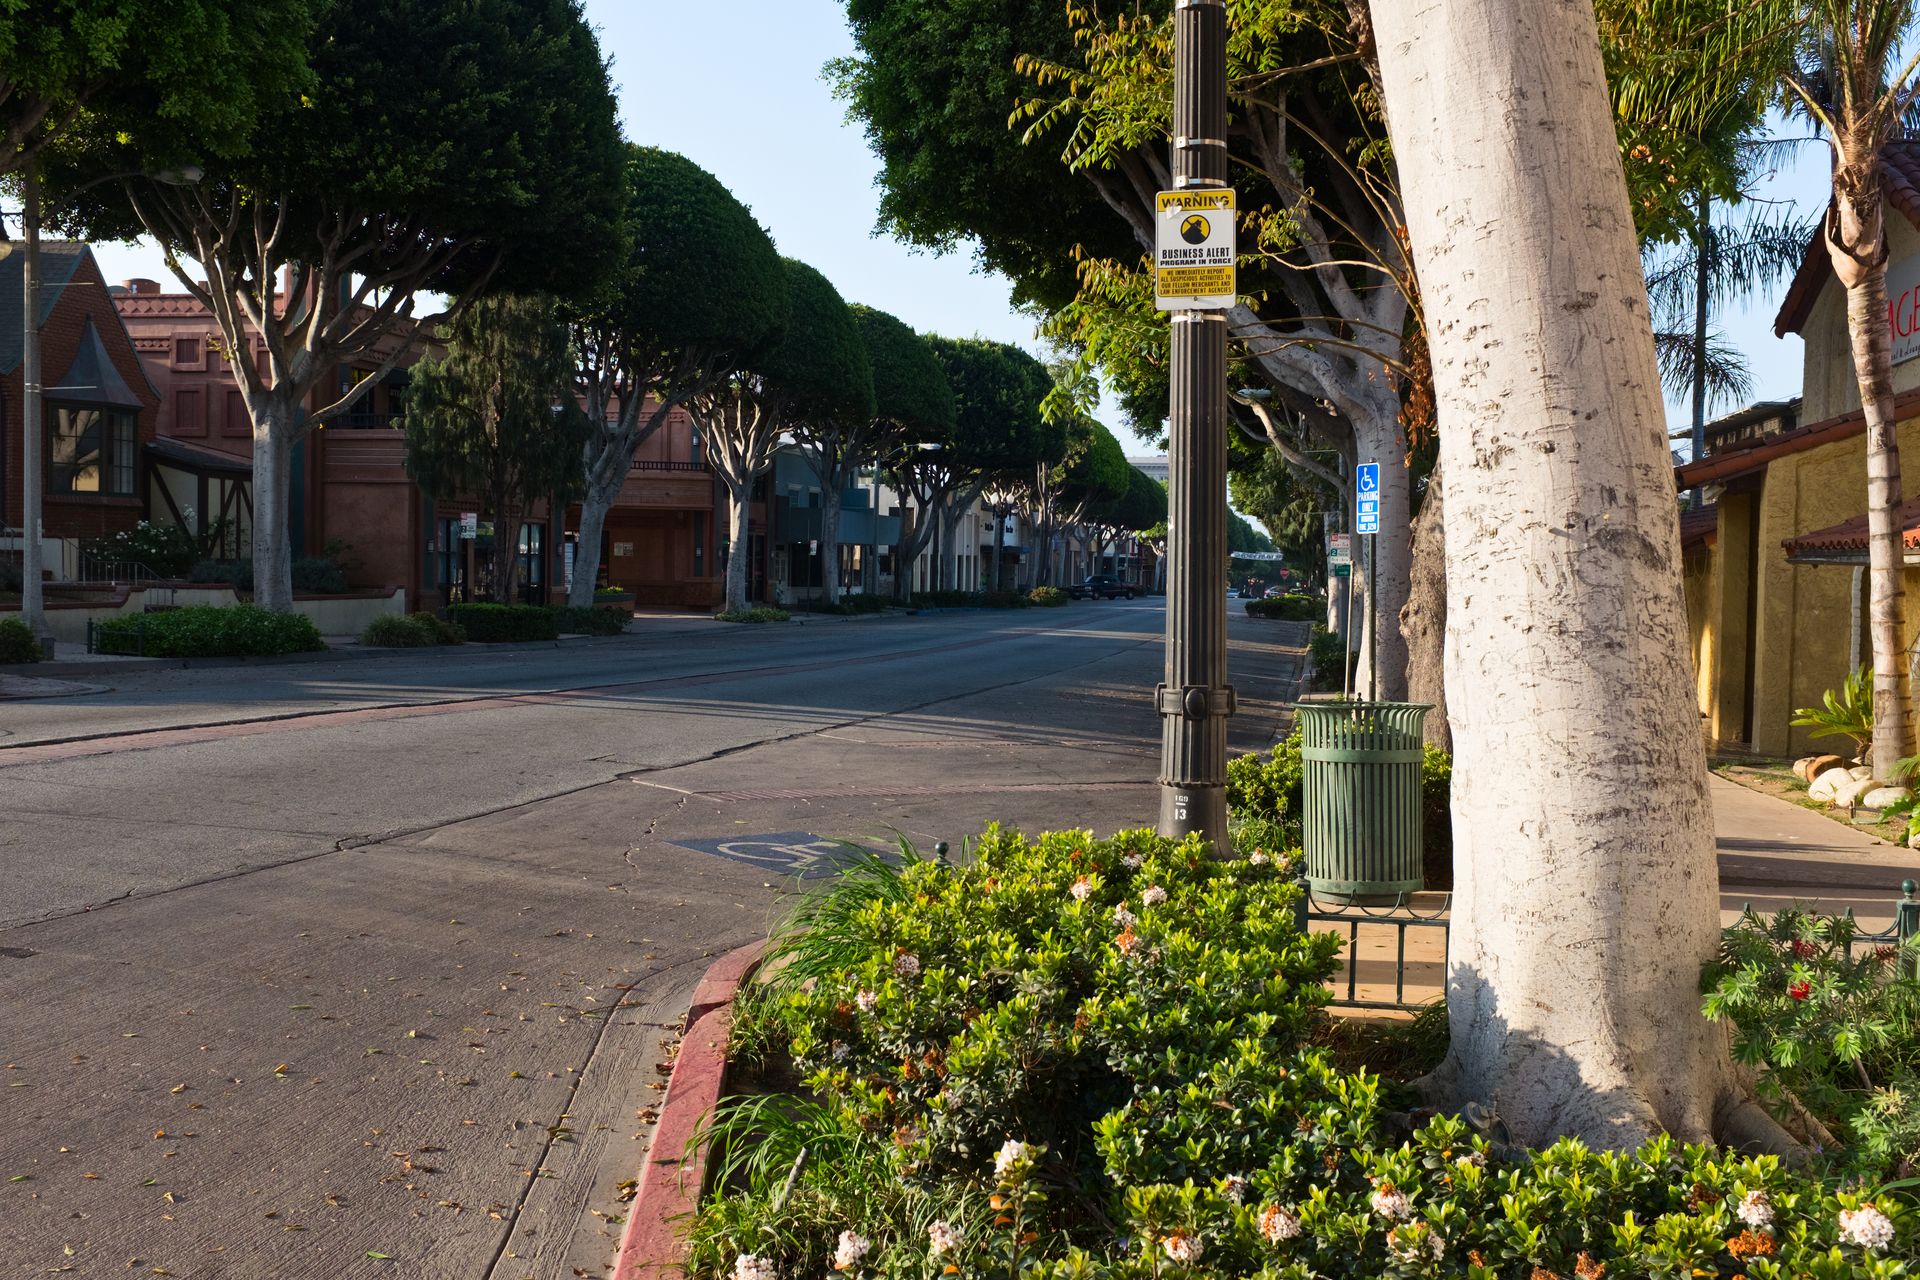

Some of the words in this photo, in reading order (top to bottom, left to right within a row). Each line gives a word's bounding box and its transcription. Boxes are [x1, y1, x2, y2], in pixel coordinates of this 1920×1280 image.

[1162, 195, 1230, 208] WARNING
[1162, 248, 1204, 260] BUSINESS
[1206, 247, 1230, 258] ALERT
[1208, 257, 1232, 265] FORCE
[1171, 287, 1207, 295] ENFORCEMENT
[1358, 491, 1378, 501] PARKING
[1175, 808, 1187, 820] 13
